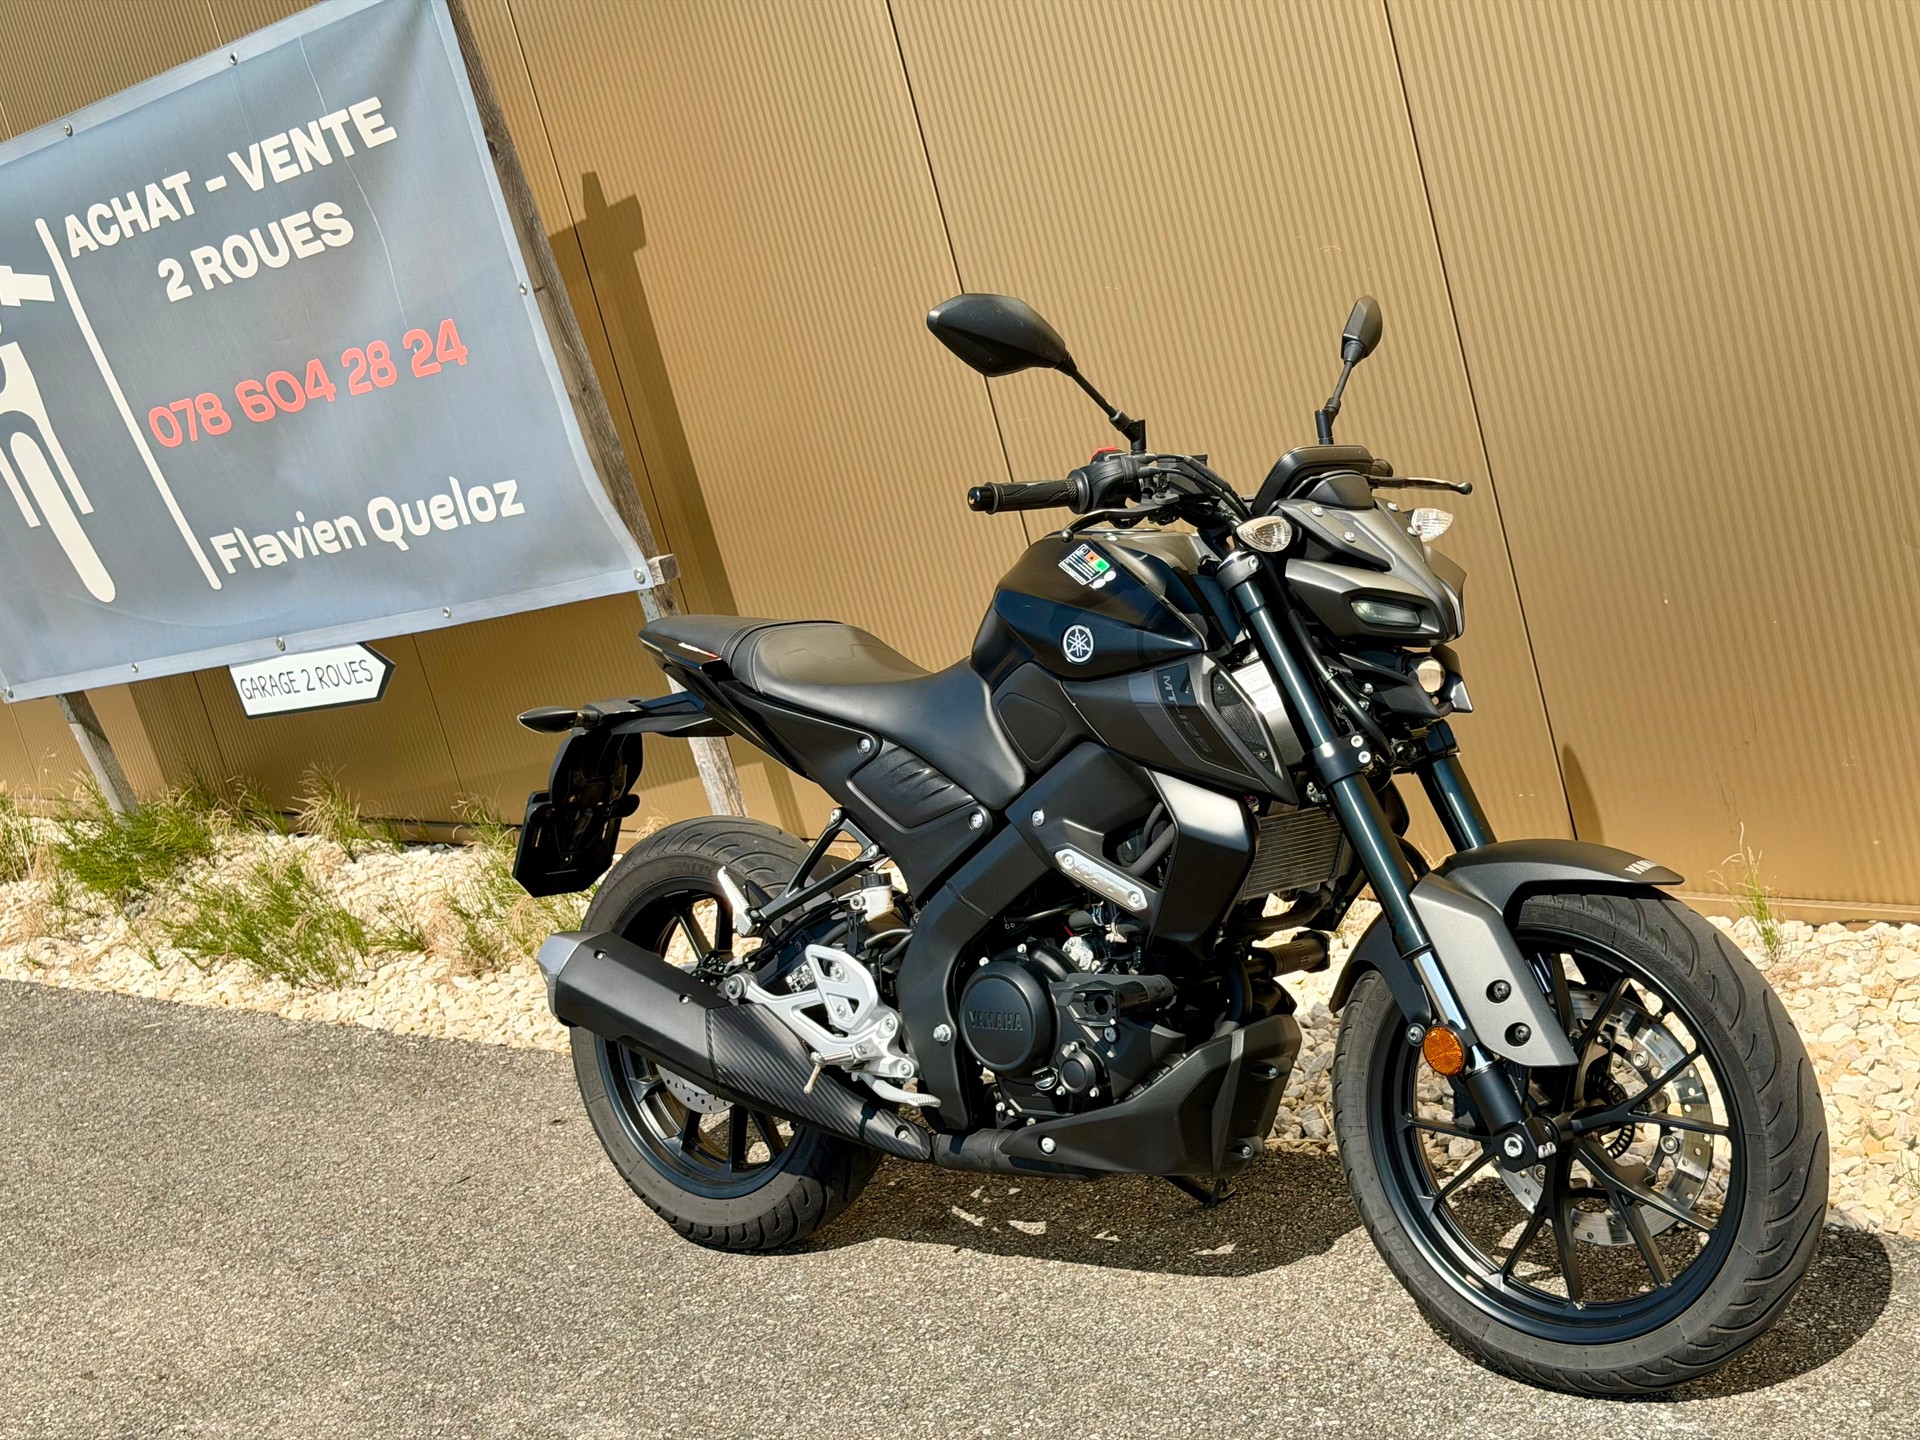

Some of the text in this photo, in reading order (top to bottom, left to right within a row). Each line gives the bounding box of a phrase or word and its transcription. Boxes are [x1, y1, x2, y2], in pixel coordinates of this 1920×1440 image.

[64, 96, 398, 259] ACHAT - VENTE
[157, 201, 354, 303] 2 ROUES
[148, 319, 468, 448] 078 604 28 24
[209, 475, 526, 575] Flavien Queloz
[239, 659, 374, 700] GARAGE 2 ROUES
[1162, 674, 1213, 753] MT-125
[967, 1009, 1024, 1032] YAMAHA
